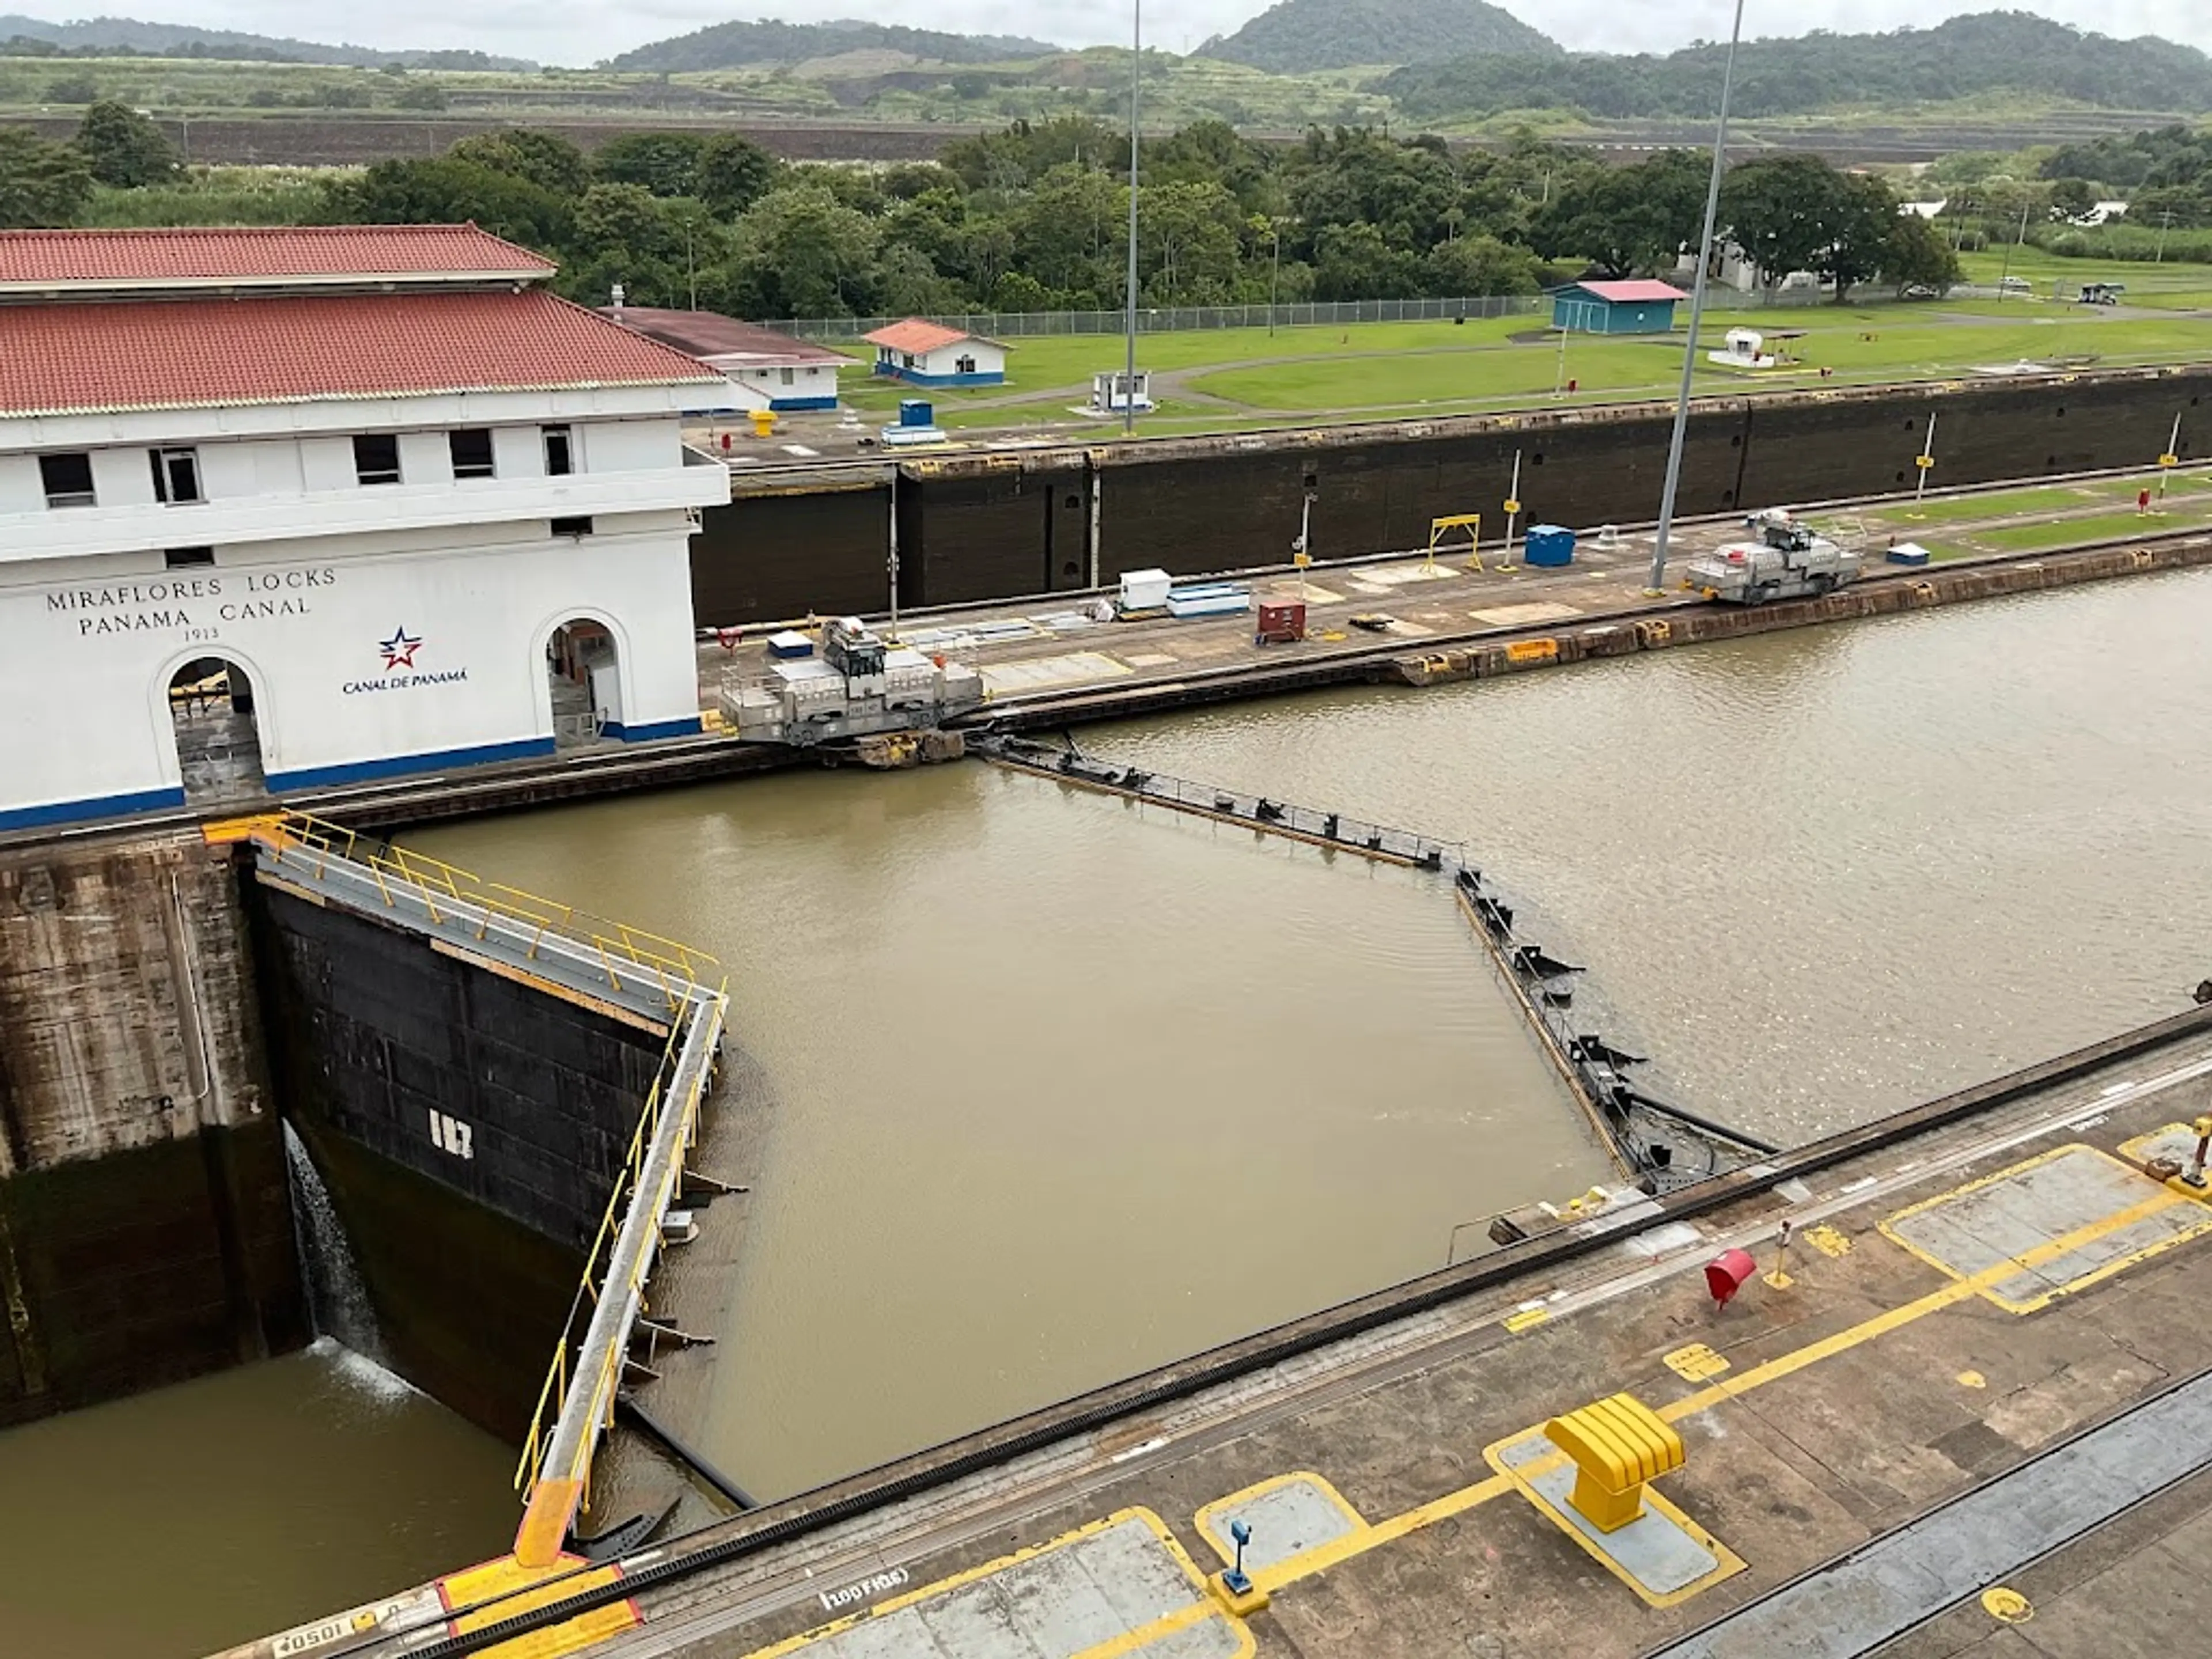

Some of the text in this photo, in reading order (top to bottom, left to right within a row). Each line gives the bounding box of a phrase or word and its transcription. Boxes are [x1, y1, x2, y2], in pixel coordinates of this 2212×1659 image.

[47, 568, 335, 611] MIRAFLORES LOCKS
[79, 597, 311, 635] PANAMA CANAL
[184, 627, 219, 642] 1913
[343, 666, 468, 694] CANAL DE PANAMÁ
